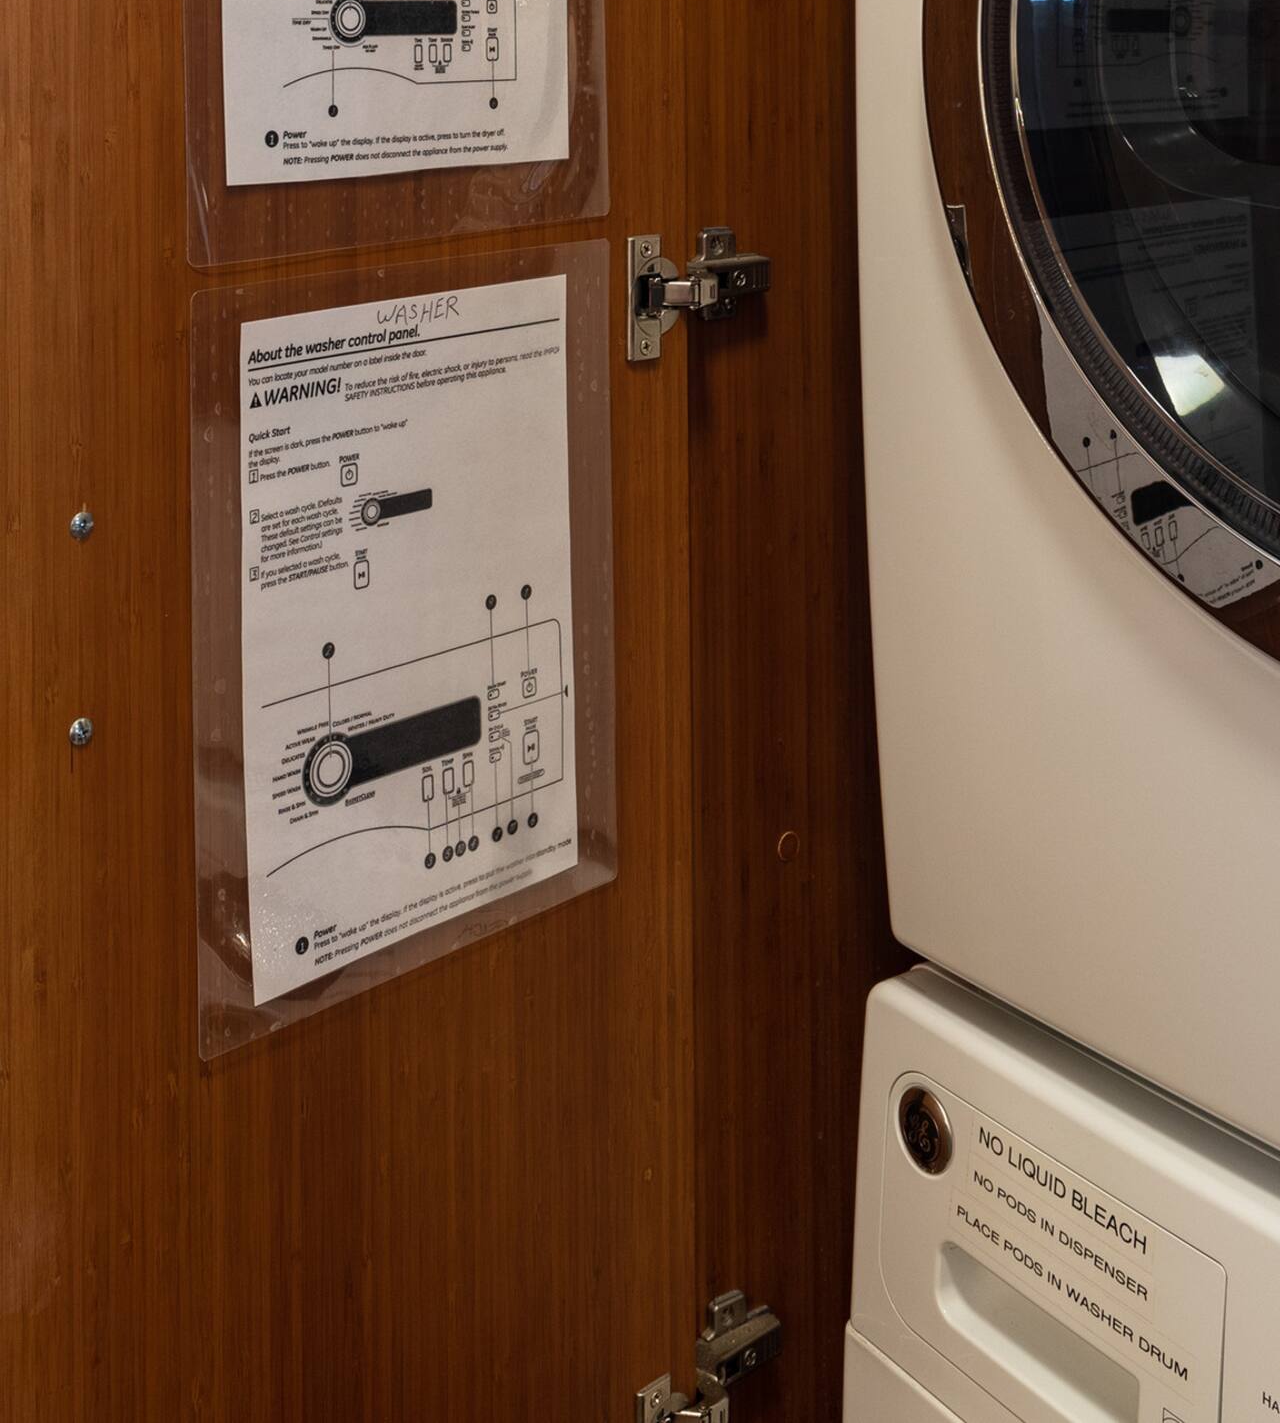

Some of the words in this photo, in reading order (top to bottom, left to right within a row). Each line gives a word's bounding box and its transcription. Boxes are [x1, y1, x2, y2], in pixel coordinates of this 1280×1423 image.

[282, 130, 307, 139] Power
[377, 296, 459, 325] WASHER
[247, 346, 283, 365] About
[284, 344, 303, 358] the
[305, 338, 346, 354] washer
[347, 329, 386, 347] control
[388, 324, 420, 343] panel.
[265, 377, 341, 406] WARNING!
[248, 430, 270, 443] Quick
[271, 426, 291, 437] Start
[979, 1126, 1003, 1156] NO
[1008, 1146, 1066, 1198] LIQUID
[1071, 1189, 1146, 1254] BLEACH
[973, 1170, 994, 1193] NO
[997, 1187, 1036, 1223] PODS
[1040, 1217, 1054, 1236] IN
[1058, 1230, 1148, 1301] DISPENSER
[956, 1205, 1000, 1246] PLACE
[1003, 1239, 1043, 1277] PODS
[1047, 1271, 1061, 1290] IN
[1066, 1284, 1133, 1342] WASHER
[1138, 1336, 1188, 1381] DRUM
